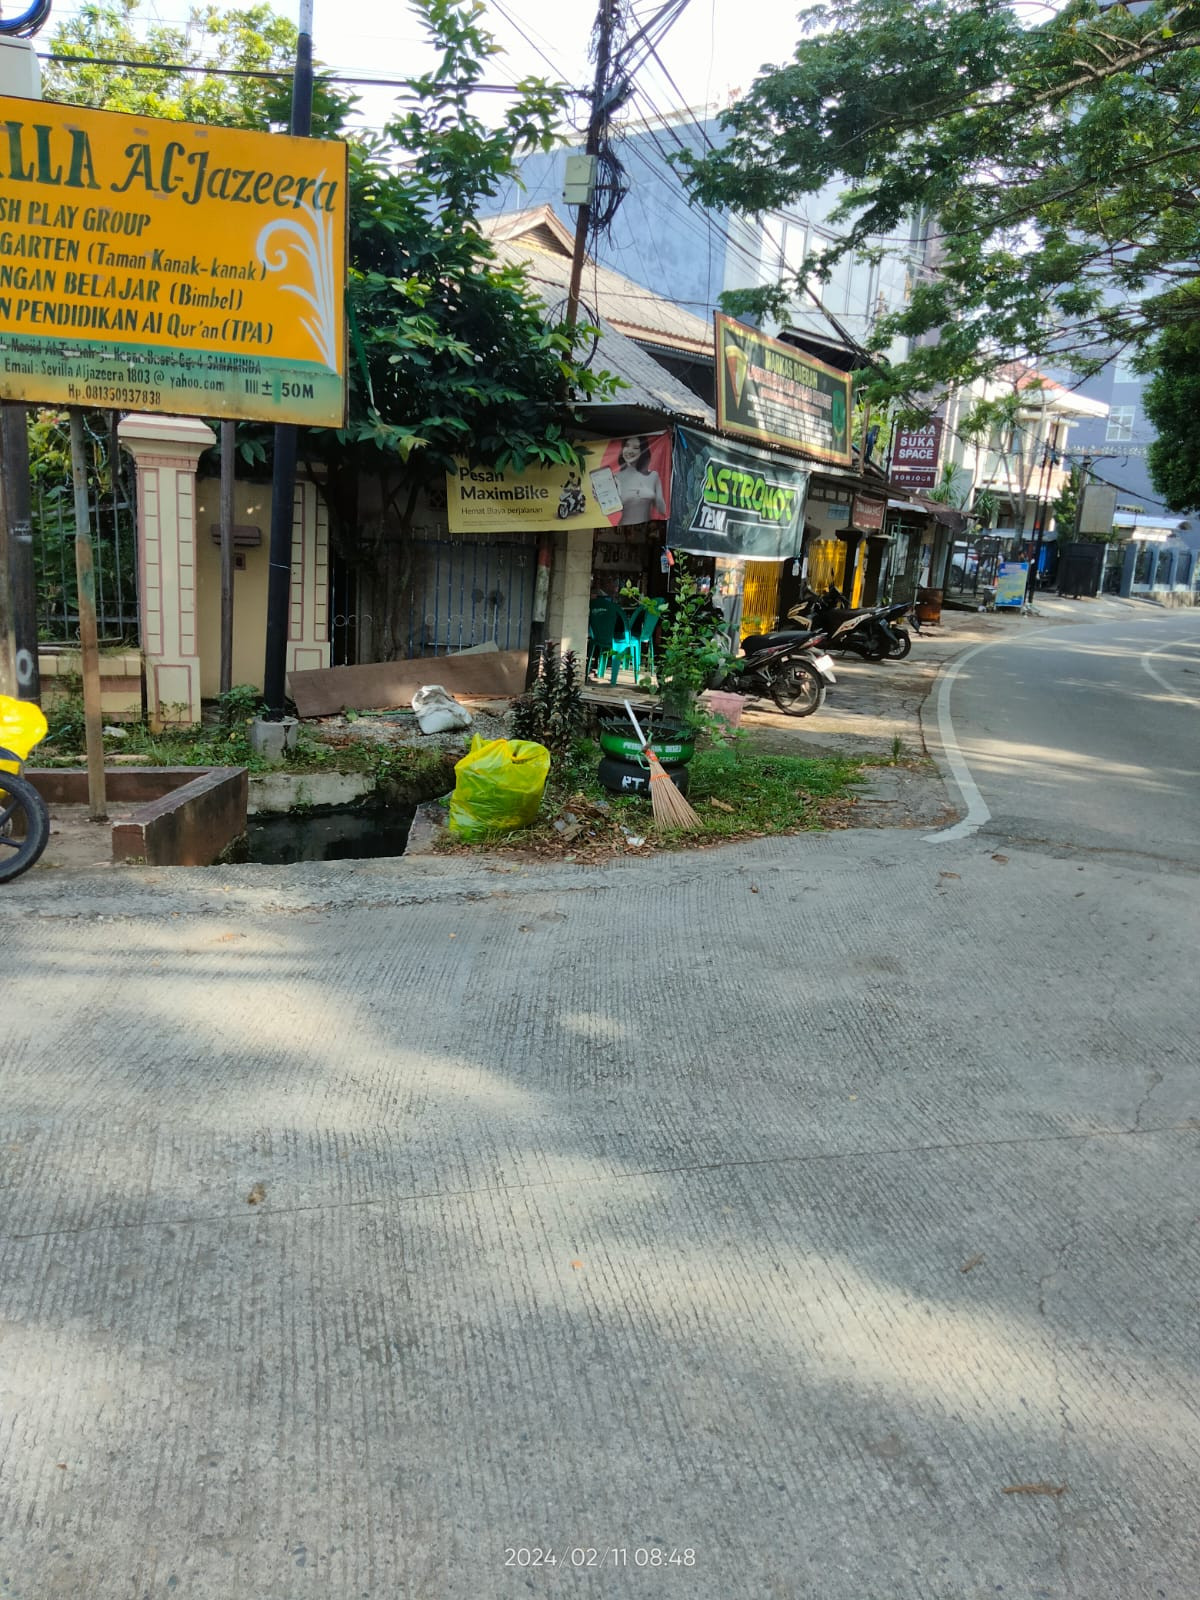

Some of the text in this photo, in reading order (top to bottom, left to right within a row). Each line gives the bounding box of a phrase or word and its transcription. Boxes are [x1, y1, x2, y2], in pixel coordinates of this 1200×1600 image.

[0, 120, 101, 190] LLA
[28, 201, 79, 230] PLAY
[83, 207, 151, 237] GROUP
[0, 232, 80, 263] GARTEN
[88, 242, 147, 270] (Taman
[64, 272, 160, 303] BELAJAR
[169, 282, 243, 311] (Bimbel)
[16, 298, 138, 332] PENDIDIKAN
[222, 318, 273, 345] (TPA)
[41, 360, 74, 378] Sevilla
[127, 367, 150, 385] 1803
[170, 374, 225, 391] yahoo.com
[899, 448, 934, 460] SPACE
[900, 437, 935, 447] SUKA
[459, 467, 505, 482] Pesan
[460, 486, 549, 501] MaximBike
[461, 507, 485, 515] Hemat
